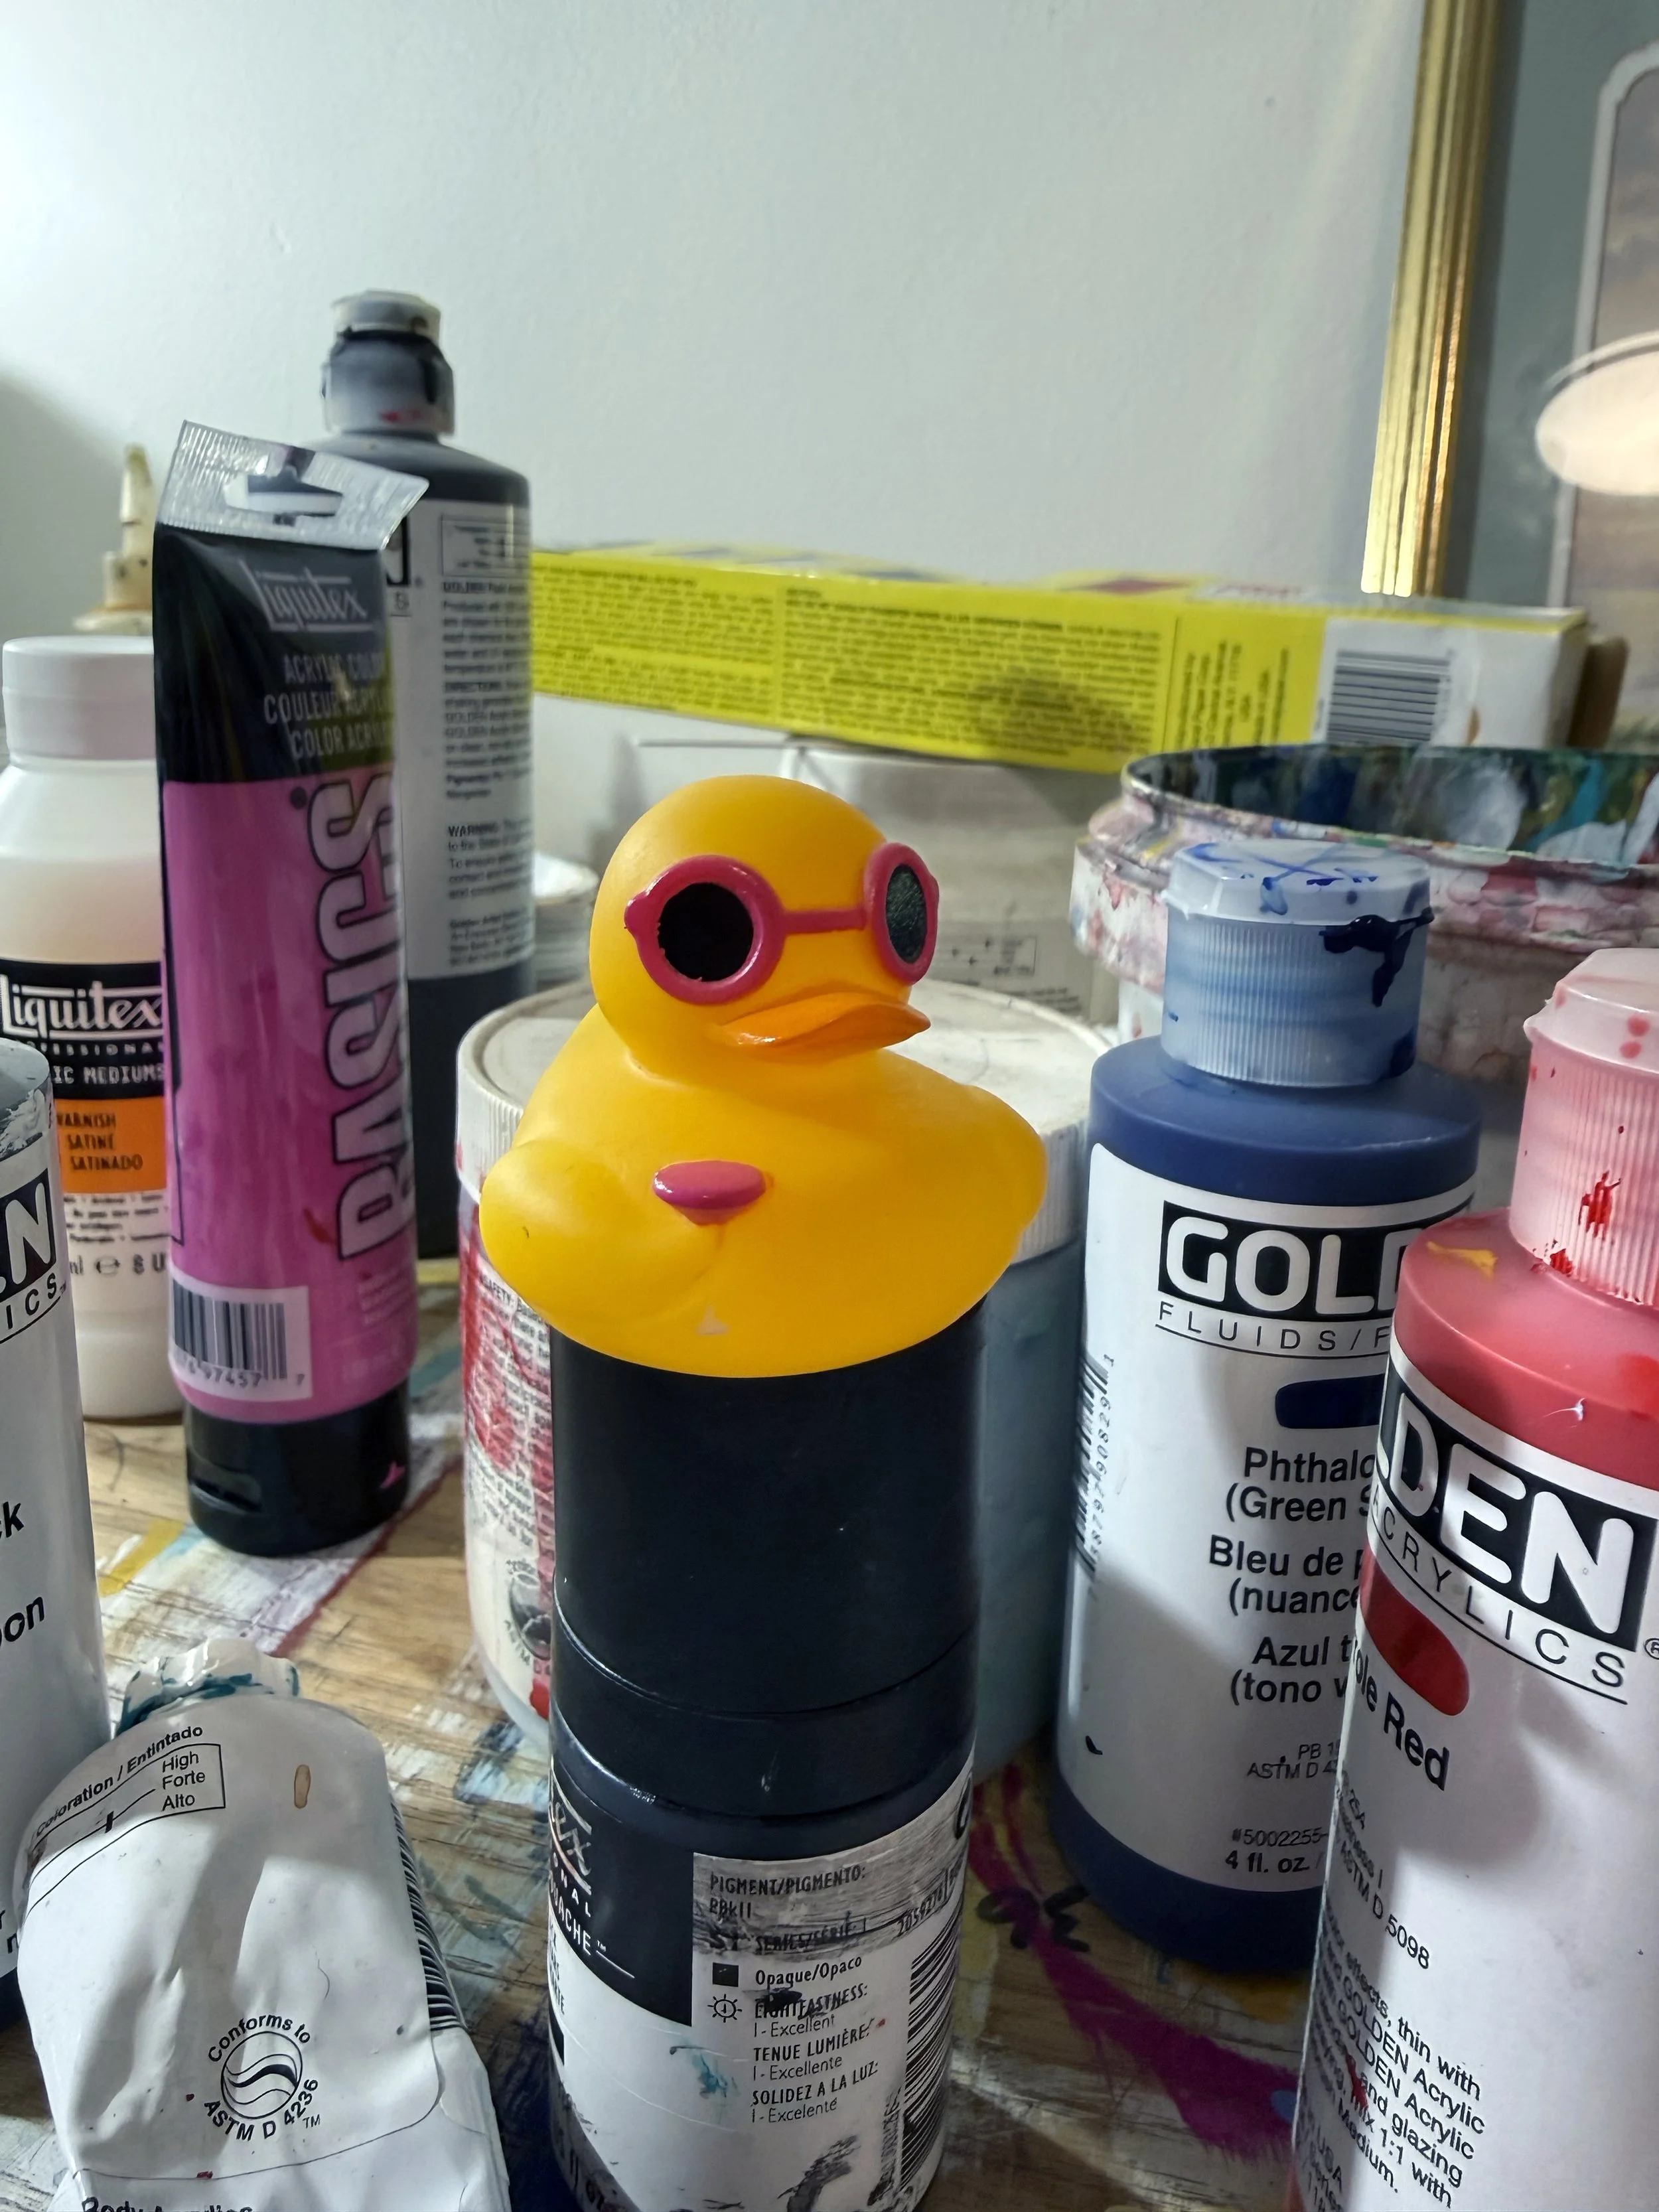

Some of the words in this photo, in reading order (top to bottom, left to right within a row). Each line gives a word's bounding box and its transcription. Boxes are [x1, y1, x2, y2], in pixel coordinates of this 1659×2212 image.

[0, 974, 163, 1039] Liquitex
[1226, 1482, 1346, 1522] (Green
[1208, 1534, 1290, 1577] Bleu
[1303, 1546, 1344, 1578] de
[1252, 1635, 1331, 1667] Azul
[1230, 1668, 1323, 1706] (tono
[127, 1726, 203, 1774] Entintado
[162, 1751, 199, 1773] High
[1297, 1743, 1322, 1760] PB
[1383, 1692, 1451, 1792] Red
[162, 1769, 206, 1790] Forte
[161, 1793, 195, 1812] Alto
[1277, 1856, 1311, 1874] oz
[1387, 1914, 1430, 1970] 5098
[755, 1956, 862, 1990] Opaque/Opaco
[208, 2014, 293, 2062] Conforms
[294, 2024, 311, 2043] to
[770, 2014, 836, 2037] Excellent
[753, 2043, 801, 2062] TENUE
[769, 2055, 843, 2081] Excellente
[1398, 2016, 1431, 2063] thin
[1437, 2055, 1480, 2101] with
[752, 2084, 813, 2106] SOLIDEZ
[816, 2081, 826, 2097] A
[831, 2074, 847, 2094] LA
[852, 2060, 879, 2085] LUZ:
[1413, 2068, 1485, 2135] Acrylic
[203, 2100, 255, 2142] ASTM
[262, 2120, 276, 2140] D
[284, 2079, 319, 2126] 4236
[768, 2096, 839, 2124] Excelente
[1404, 2093, 1475, 2160] Acrylic
[1392, 2112, 1463, 2189] glazing
[1411, 2162, 1452, 2209] with
